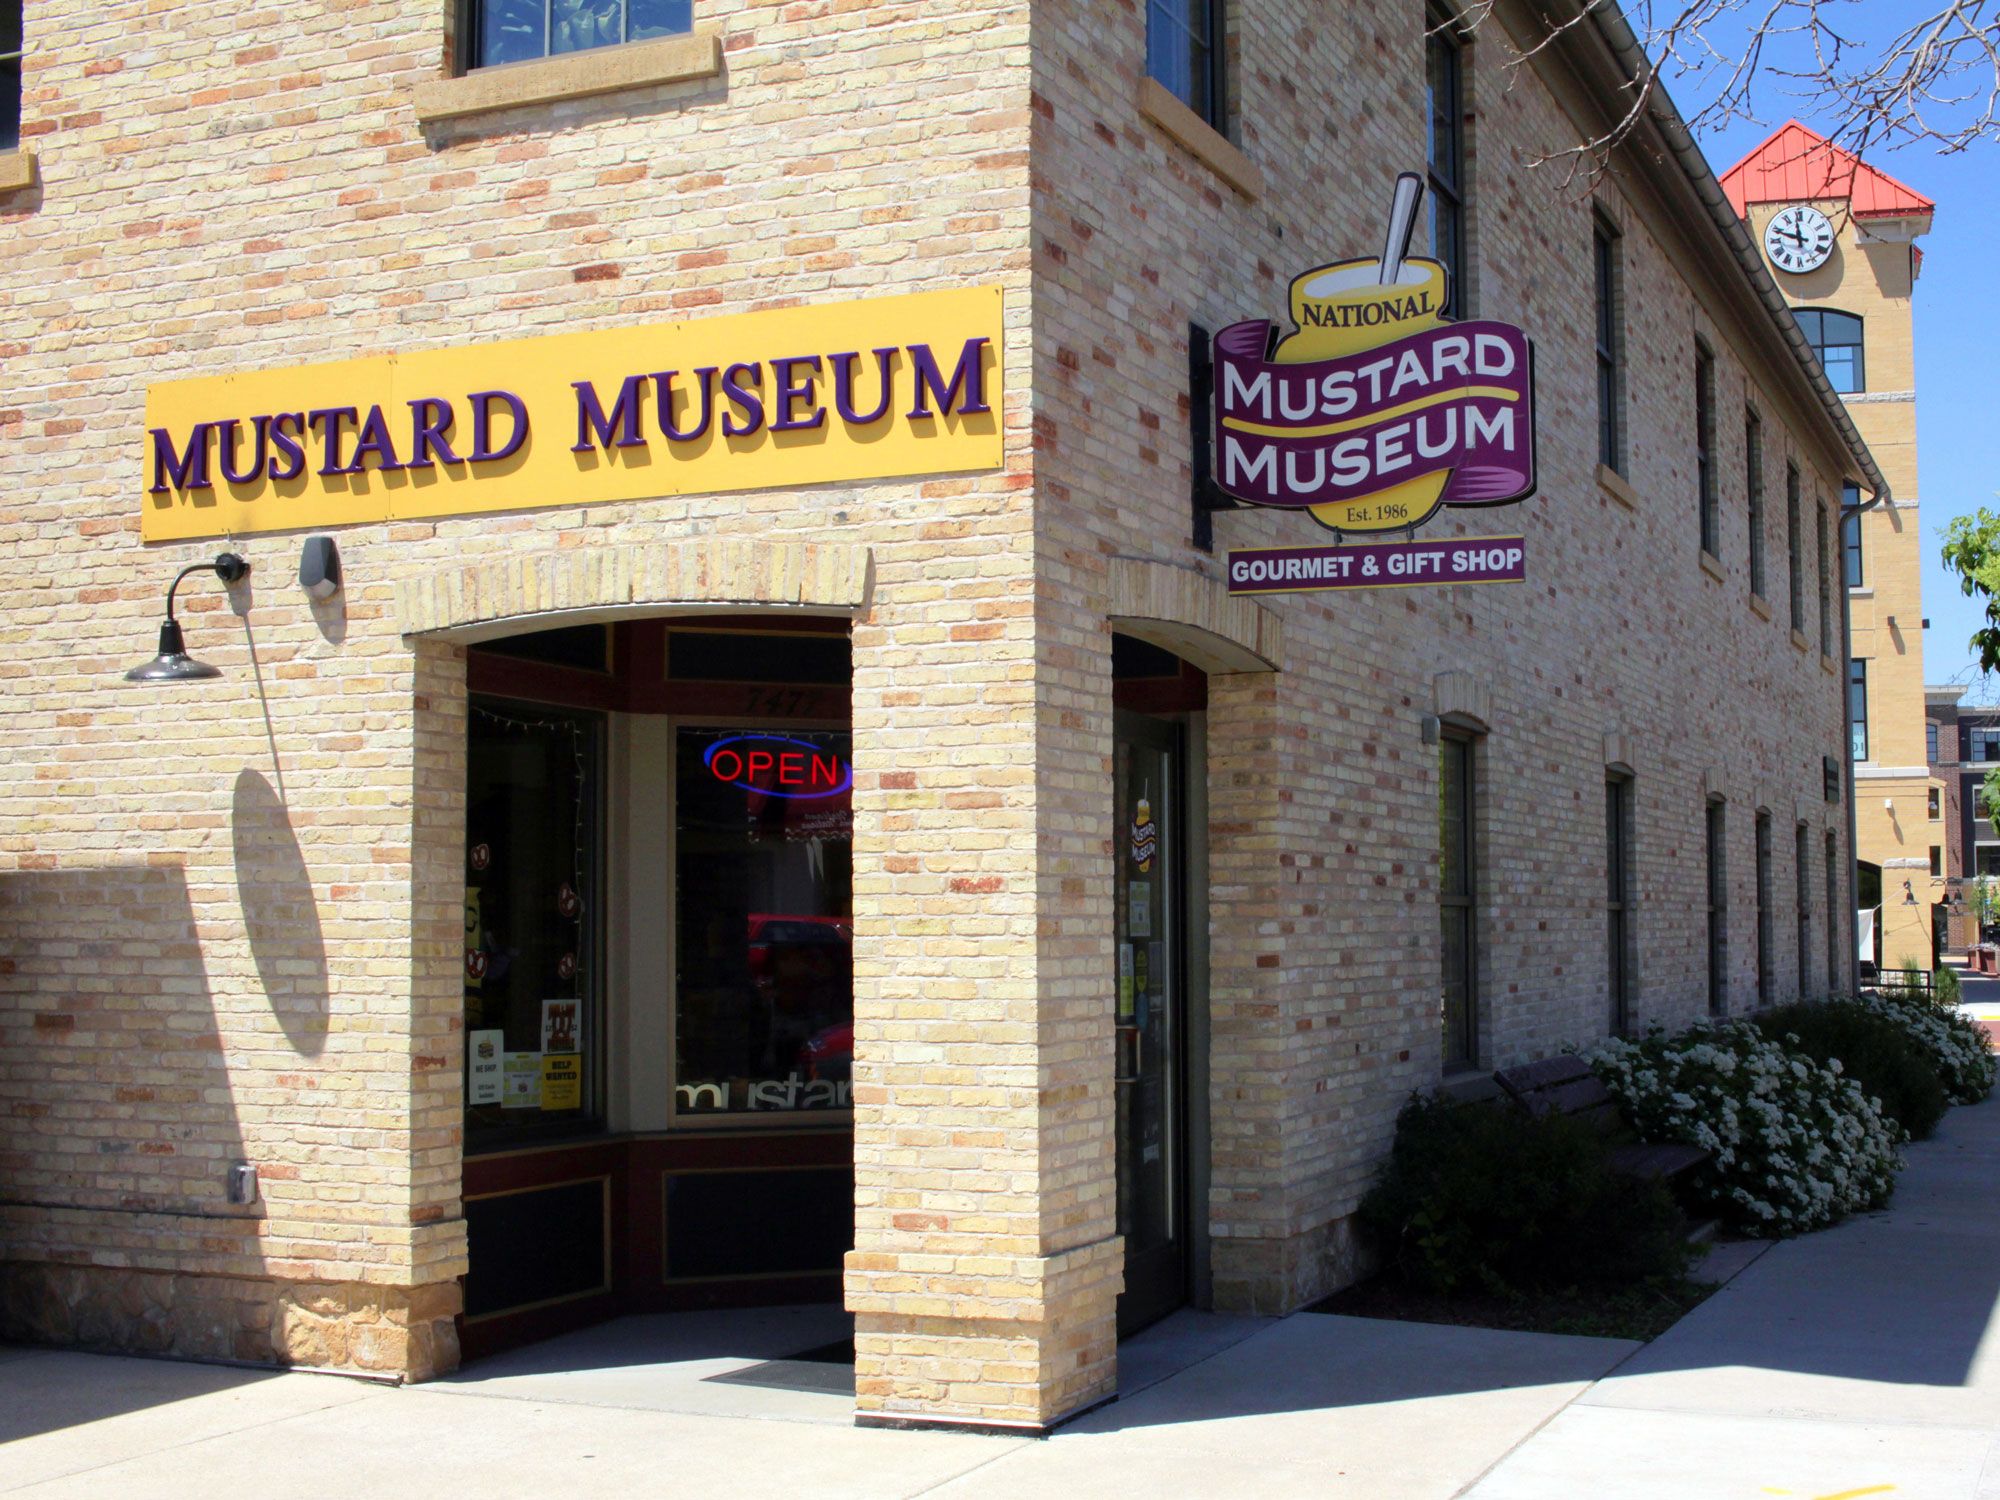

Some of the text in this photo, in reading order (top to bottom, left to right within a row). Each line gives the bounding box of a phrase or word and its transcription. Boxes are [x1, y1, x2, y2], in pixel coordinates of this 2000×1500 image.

[1302, 291, 1435, 328] NATIONAL
[1223, 333, 1515, 420] MUSTARD
[148, 336, 992, 494] MUSTARD MUSEUM
[1225, 405, 1515, 496] MUSEUM
[1346, 503, 1409, 523] Est. 1986
[1231, 547, 1523, 582] GOURMET & GIFT SHOP
[710, 749, 839, 786] OPEN
